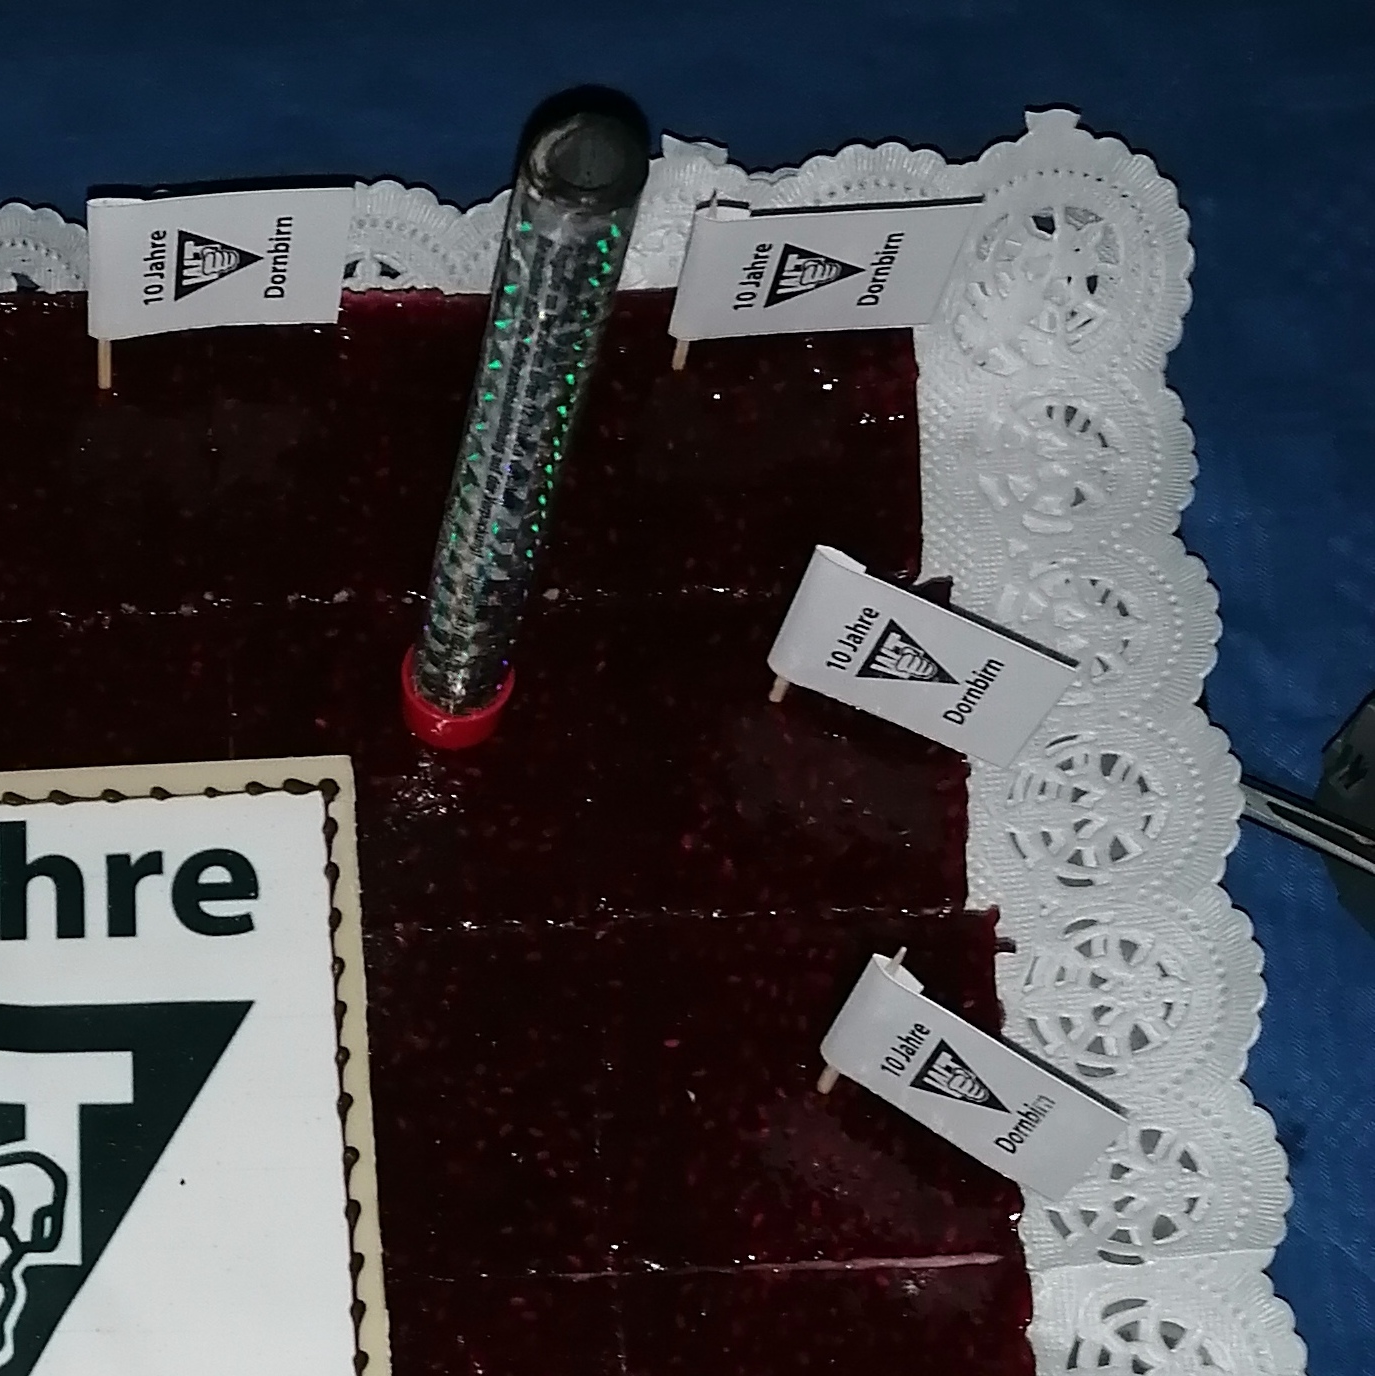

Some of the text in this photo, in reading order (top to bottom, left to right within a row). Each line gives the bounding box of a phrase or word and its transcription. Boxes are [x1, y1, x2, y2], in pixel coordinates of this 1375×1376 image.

[143, 230, 166, 305] 10 Jahre
[264, 216, 293, 298] Dornbirn
[733, 243, 773, 310] 10 Jahre
[857, 232, 905, 306] Dornbirn
[826, 607, 879, 670] 10 Jahre
[943, 659, 1005, 725] Dornbirn
[881, 1023, 930, 1076] 10 Jahre
[994, 1095, 1056, 1154] Dornbirn
